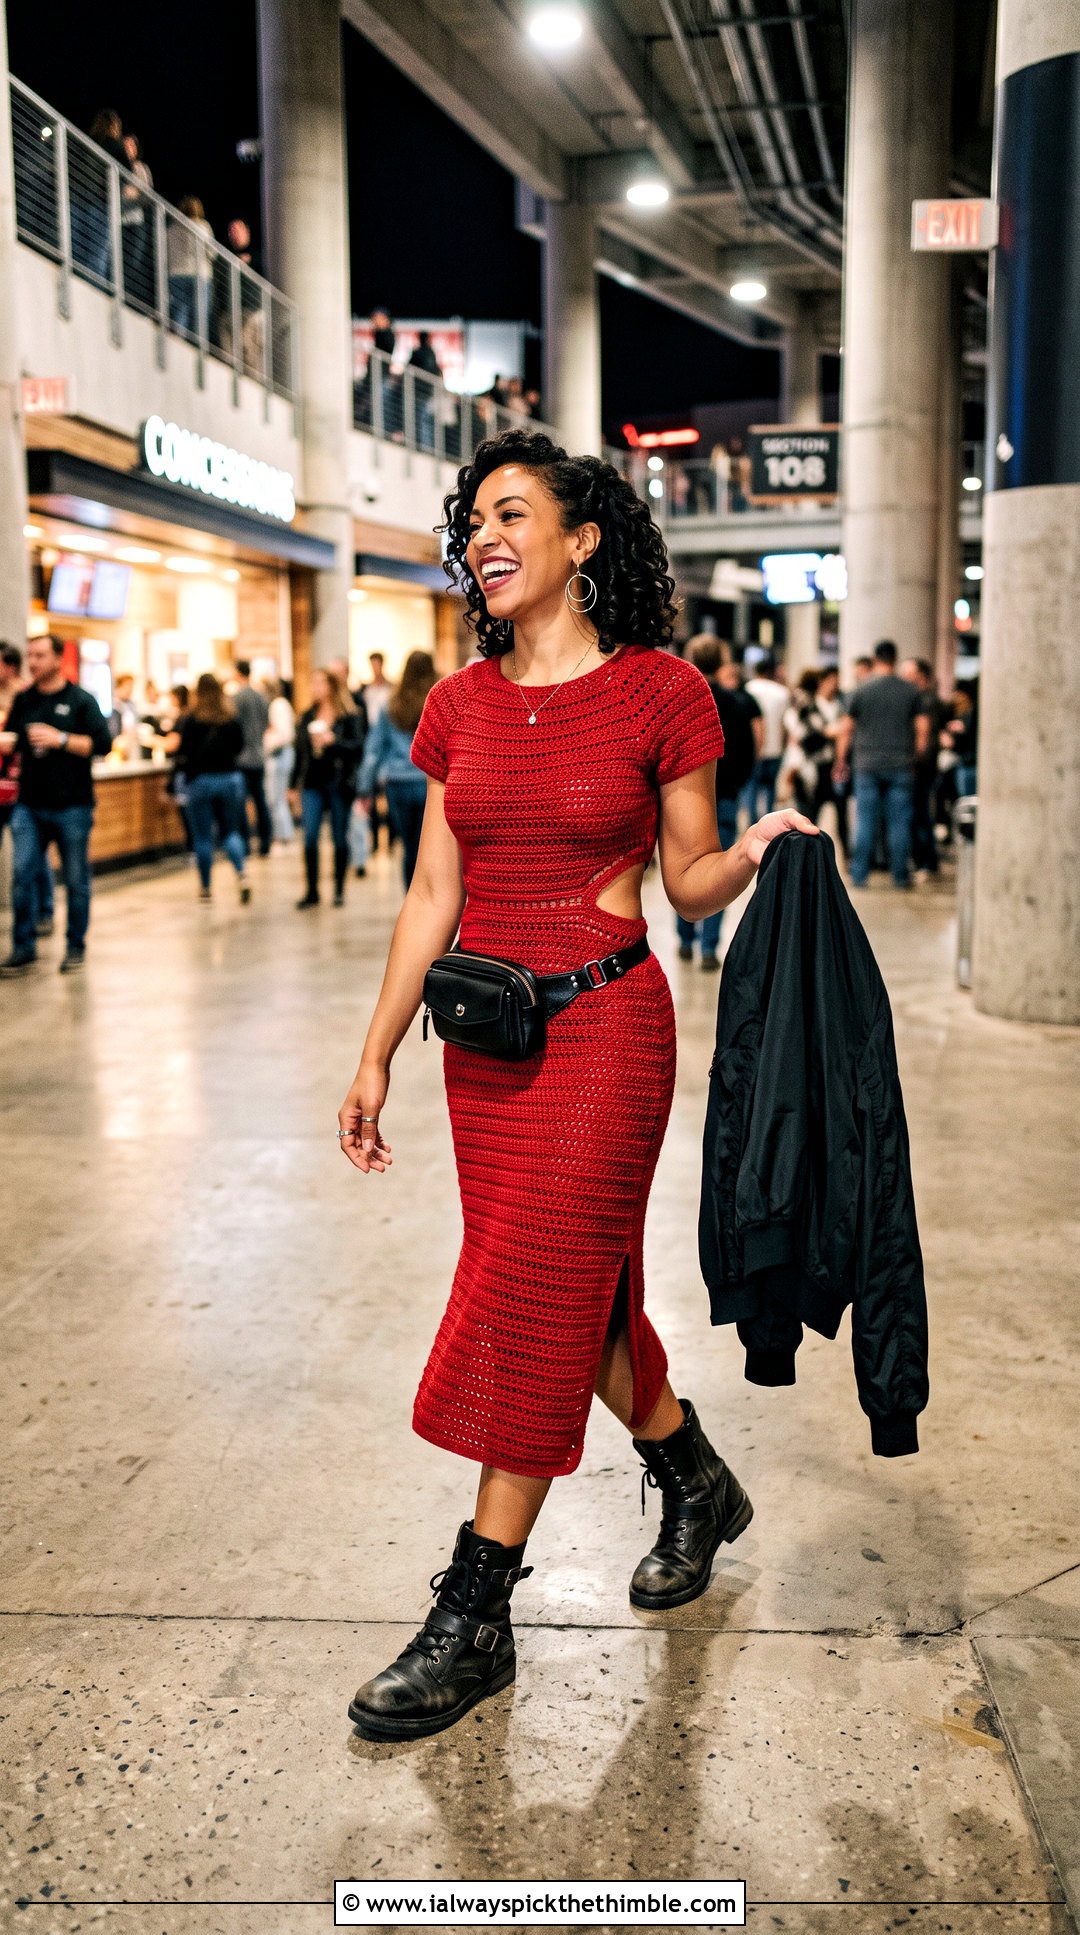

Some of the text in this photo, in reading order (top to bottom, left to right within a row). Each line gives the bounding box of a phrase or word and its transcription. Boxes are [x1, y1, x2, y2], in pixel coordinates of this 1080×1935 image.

[927, 203, 983, 246] EXIT
[762, 438, 829, 454] SECTION
[764, 456, 826, 487] 108
